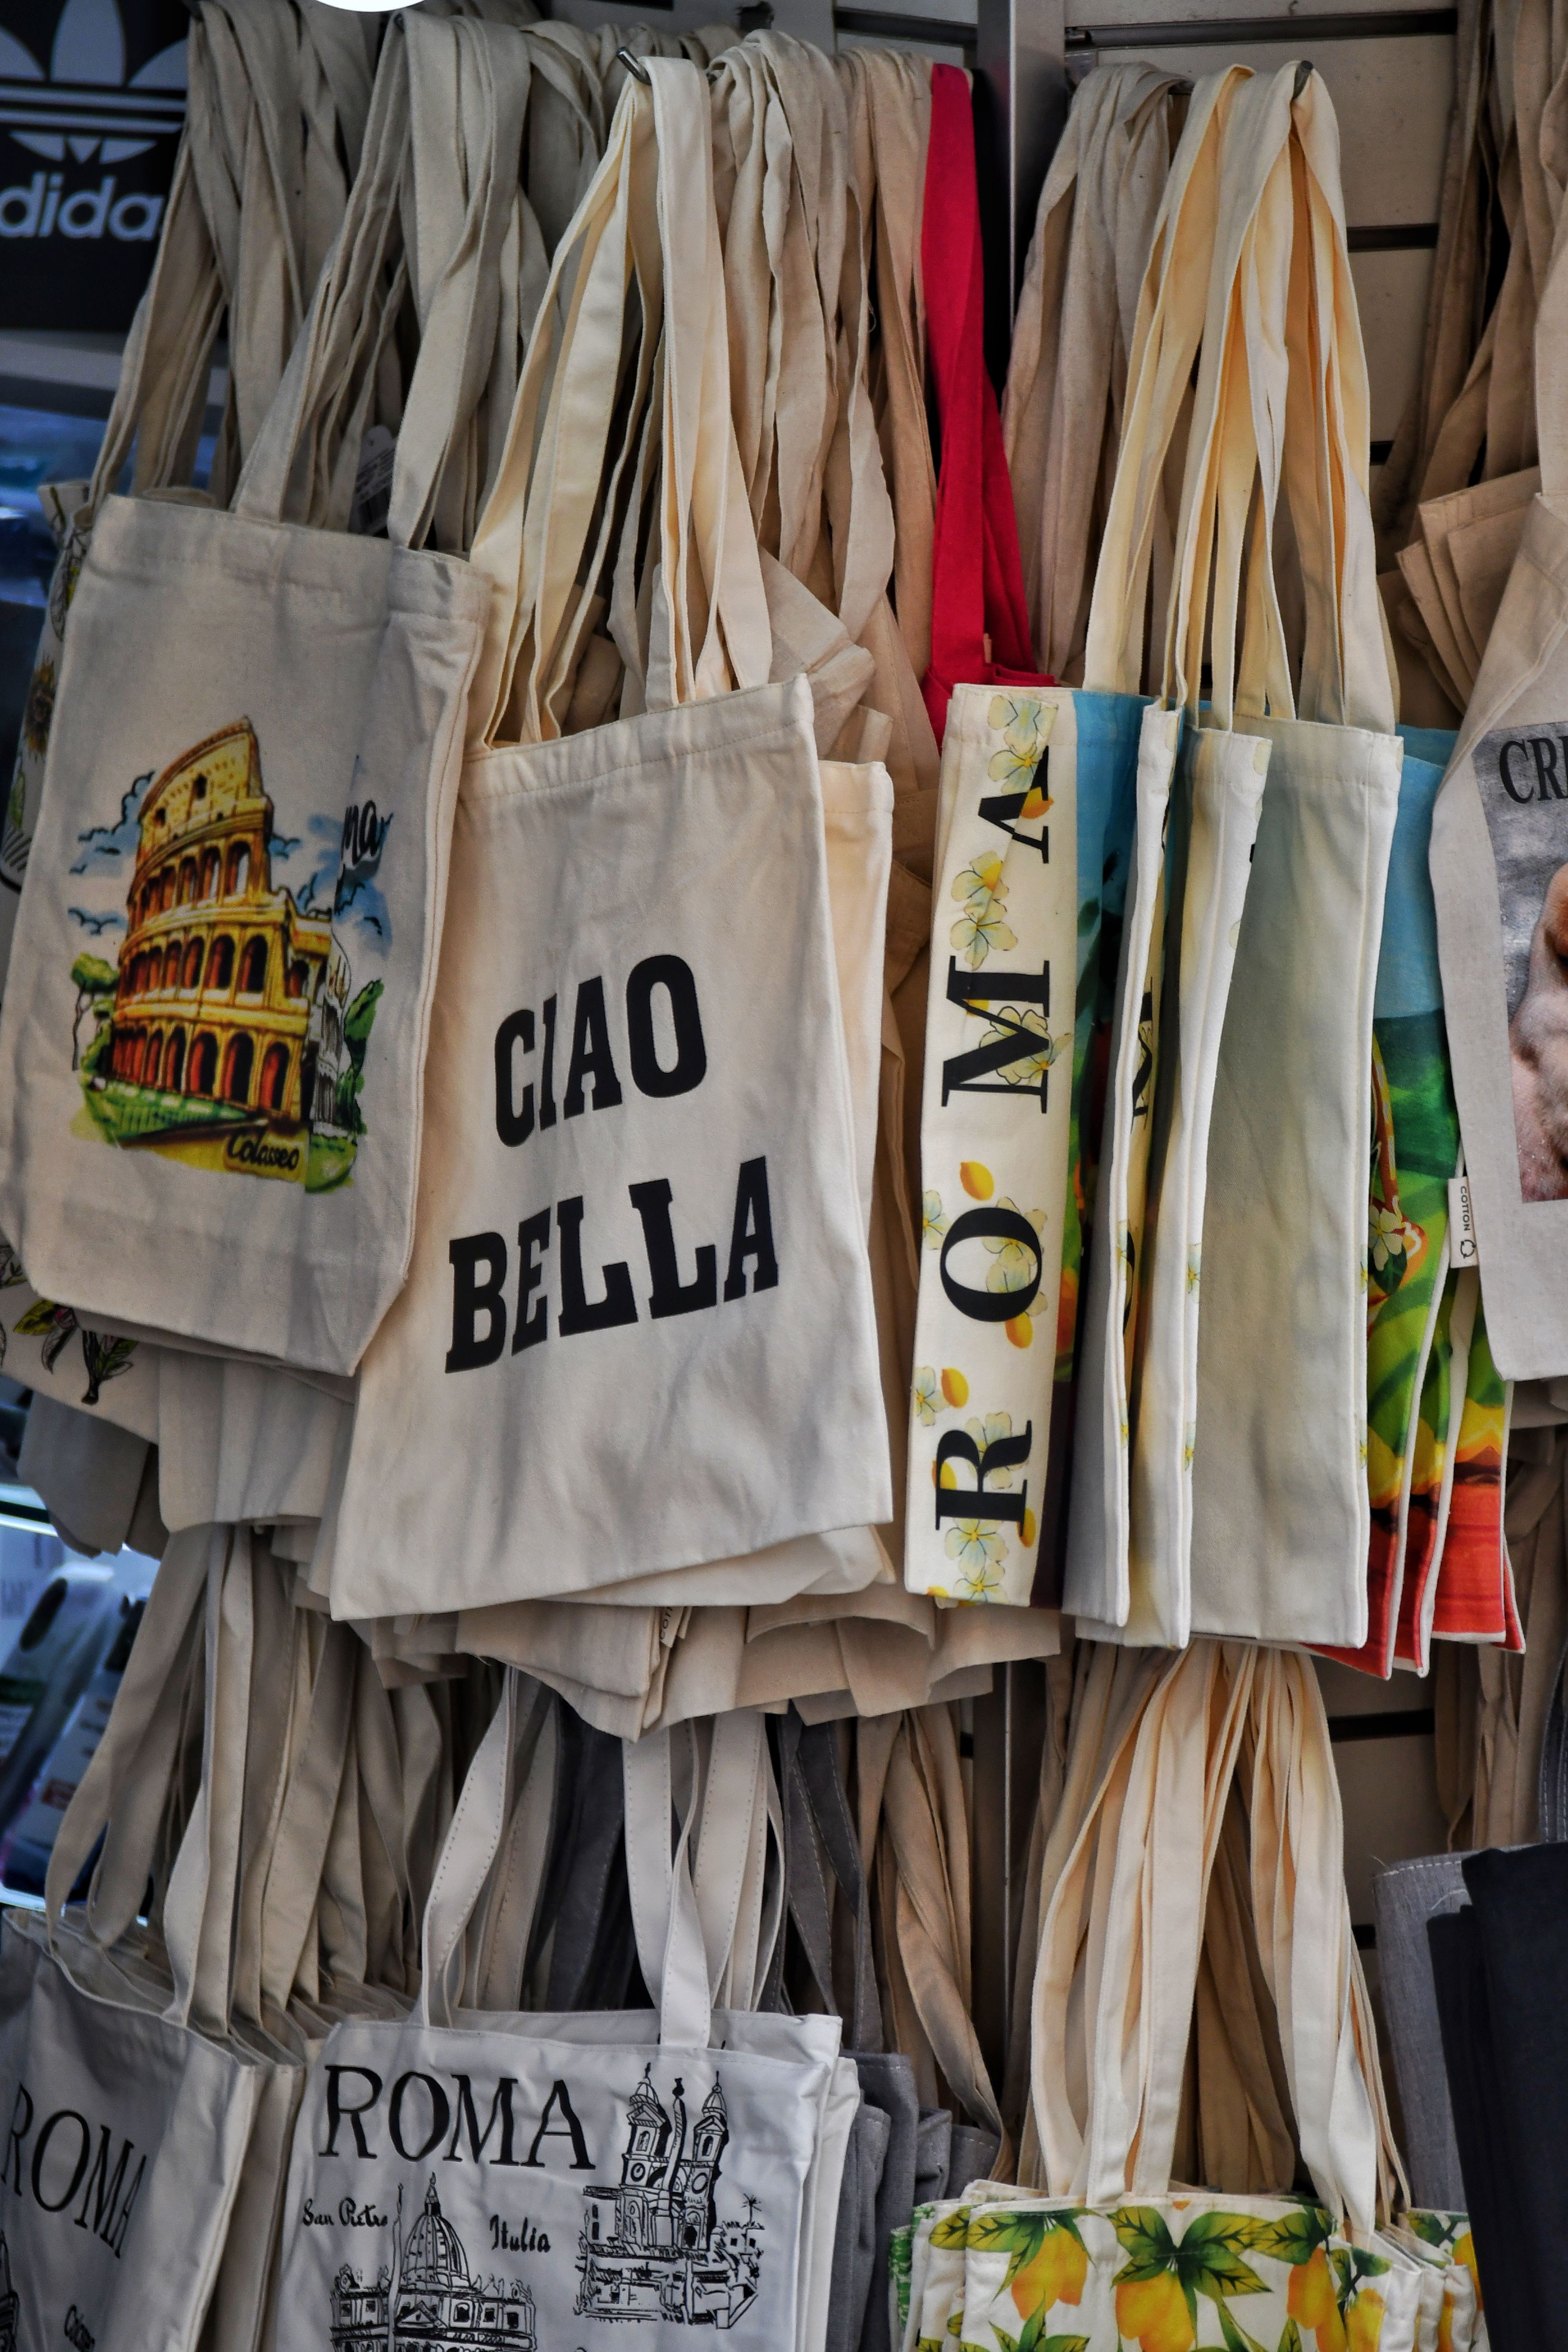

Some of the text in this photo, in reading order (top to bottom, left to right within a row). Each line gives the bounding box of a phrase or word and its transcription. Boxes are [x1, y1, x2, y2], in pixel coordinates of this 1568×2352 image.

[0, 171, 166, 241] dida
[494, 954, 706, 1147] CIAO
[935, 745, 1050, 1538] ROMA
[1460, 1186, 1471, 1231] COTTON
[445, 1155, 779, 1373] BELLA
[1, 2082, 146, 2259] ROMA
[318, 2064, 596, 2170] ROMA
[303, 2197, 388, 2227] San Pietro
